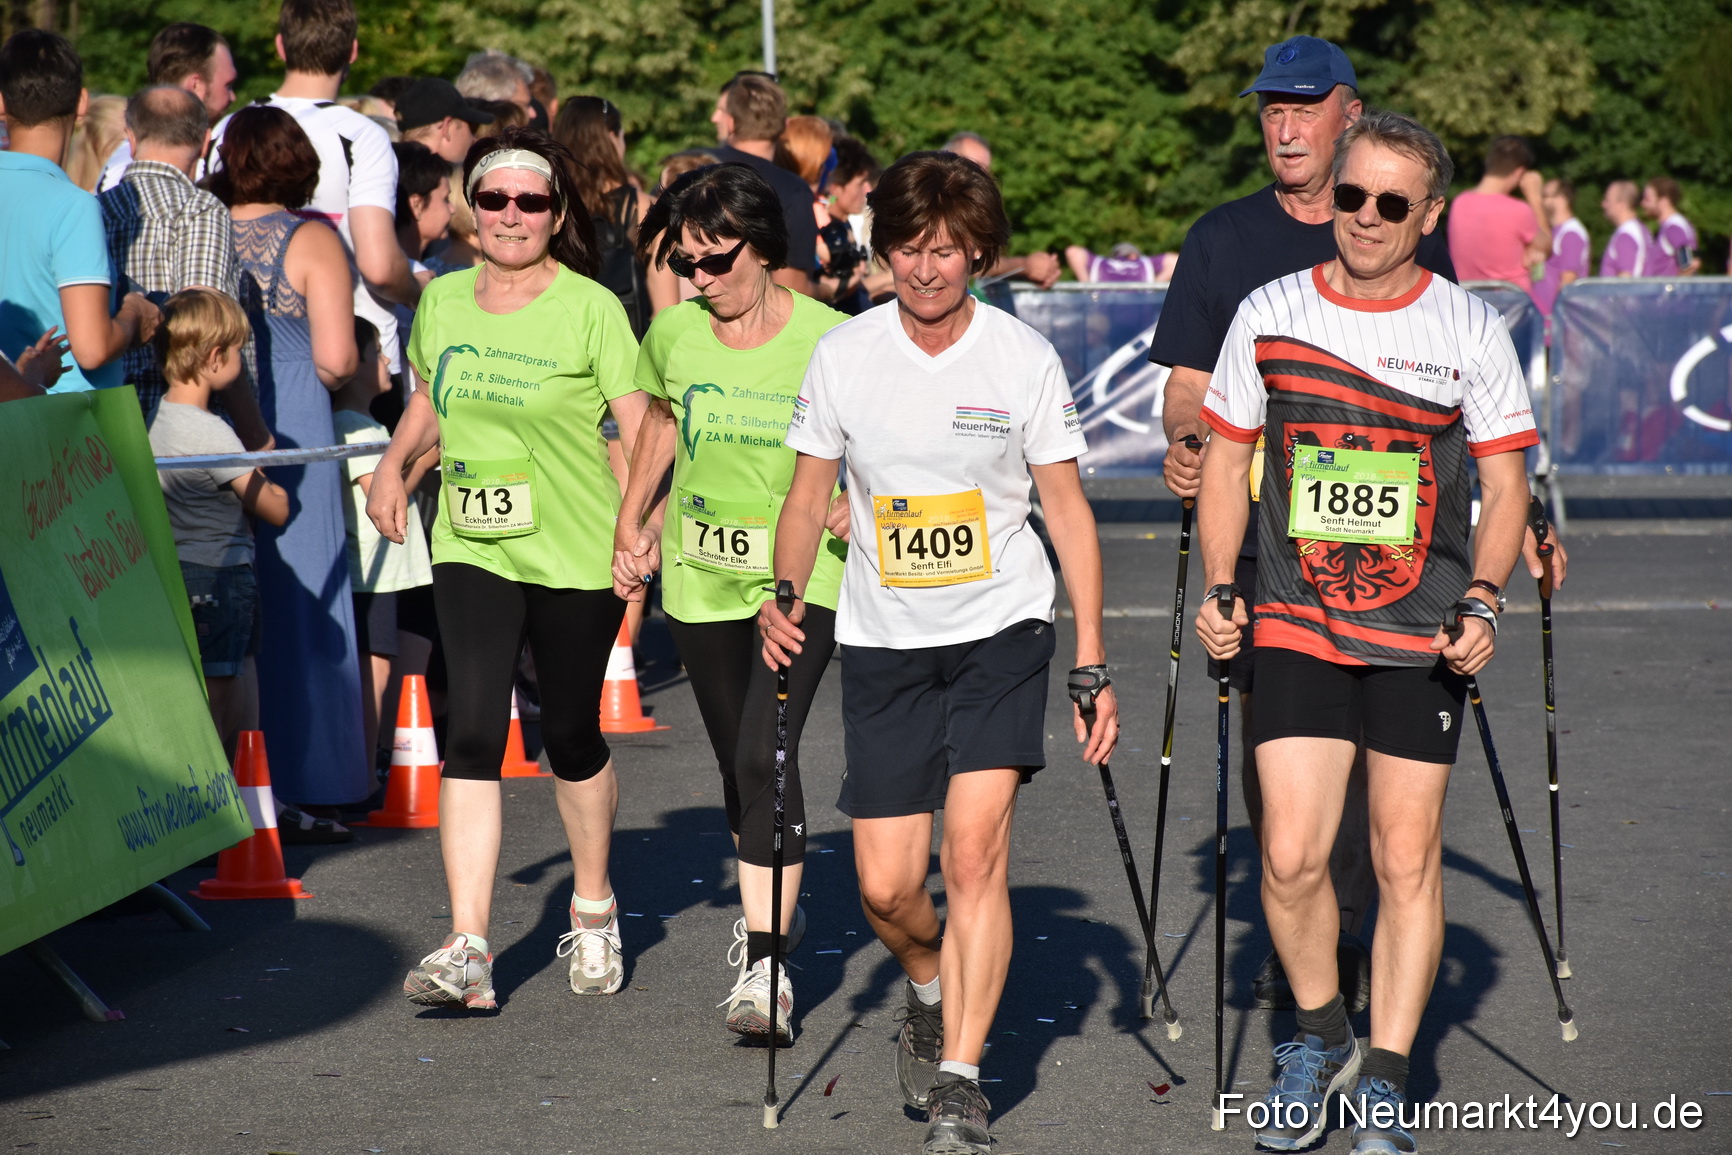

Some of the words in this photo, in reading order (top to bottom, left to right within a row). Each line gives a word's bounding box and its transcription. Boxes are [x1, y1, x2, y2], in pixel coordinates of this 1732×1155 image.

[484, 346, 558, 369] Zahnarztpraxis
[1377, 356, 1450, 378] NEUMARKT
[460, 371, 474, 381] Dr.
[475, 372, 485, 383] R.
[488, 374, 540, 391] Silberhorn
[456, 387, 469, 400] ZA
[472, 389, 483, 401] M.
[486, 391, 525, 408] Michalk
[707, 412, 722, 425] Dr.
[725, 414, 737, 426] R.
[952, 420, 1011, 434] NeuerMarkt
[705, 431, 721, 443] ZA
[723, 433, 737, 444] M.
[740, 436, 782, 449] Michalk
[1309, 460, 1350, 472] firmenlauf
[457, 486, 513, 516] 713
[1307, 480, 1399, 518] 1885
[464, 516, 492, 525] Eckhoff
[494, 516, 509, 525] Ute
[886, 509, 923, 518] firmenlauf
[1320, 515, 1345, 525] Senft
[1347, 517, 1381, 528] Helmut
[695, 520, 750, 556] 716
[1325, 525, 1343, 533] Stadt
[1343, 527, 1375, 535] Neumarkt
[888, 524, 974, 560] 1409
[698, 548, 729, 563] Schröter
[730, 557, 748, 565] Elke
[910, 562, 935, 571] Senft
[937, 560, 952, 569] Elfi
[1173, 612, 1182, 646] NORDIC
[19, 774, 74, 849] neumarkt
